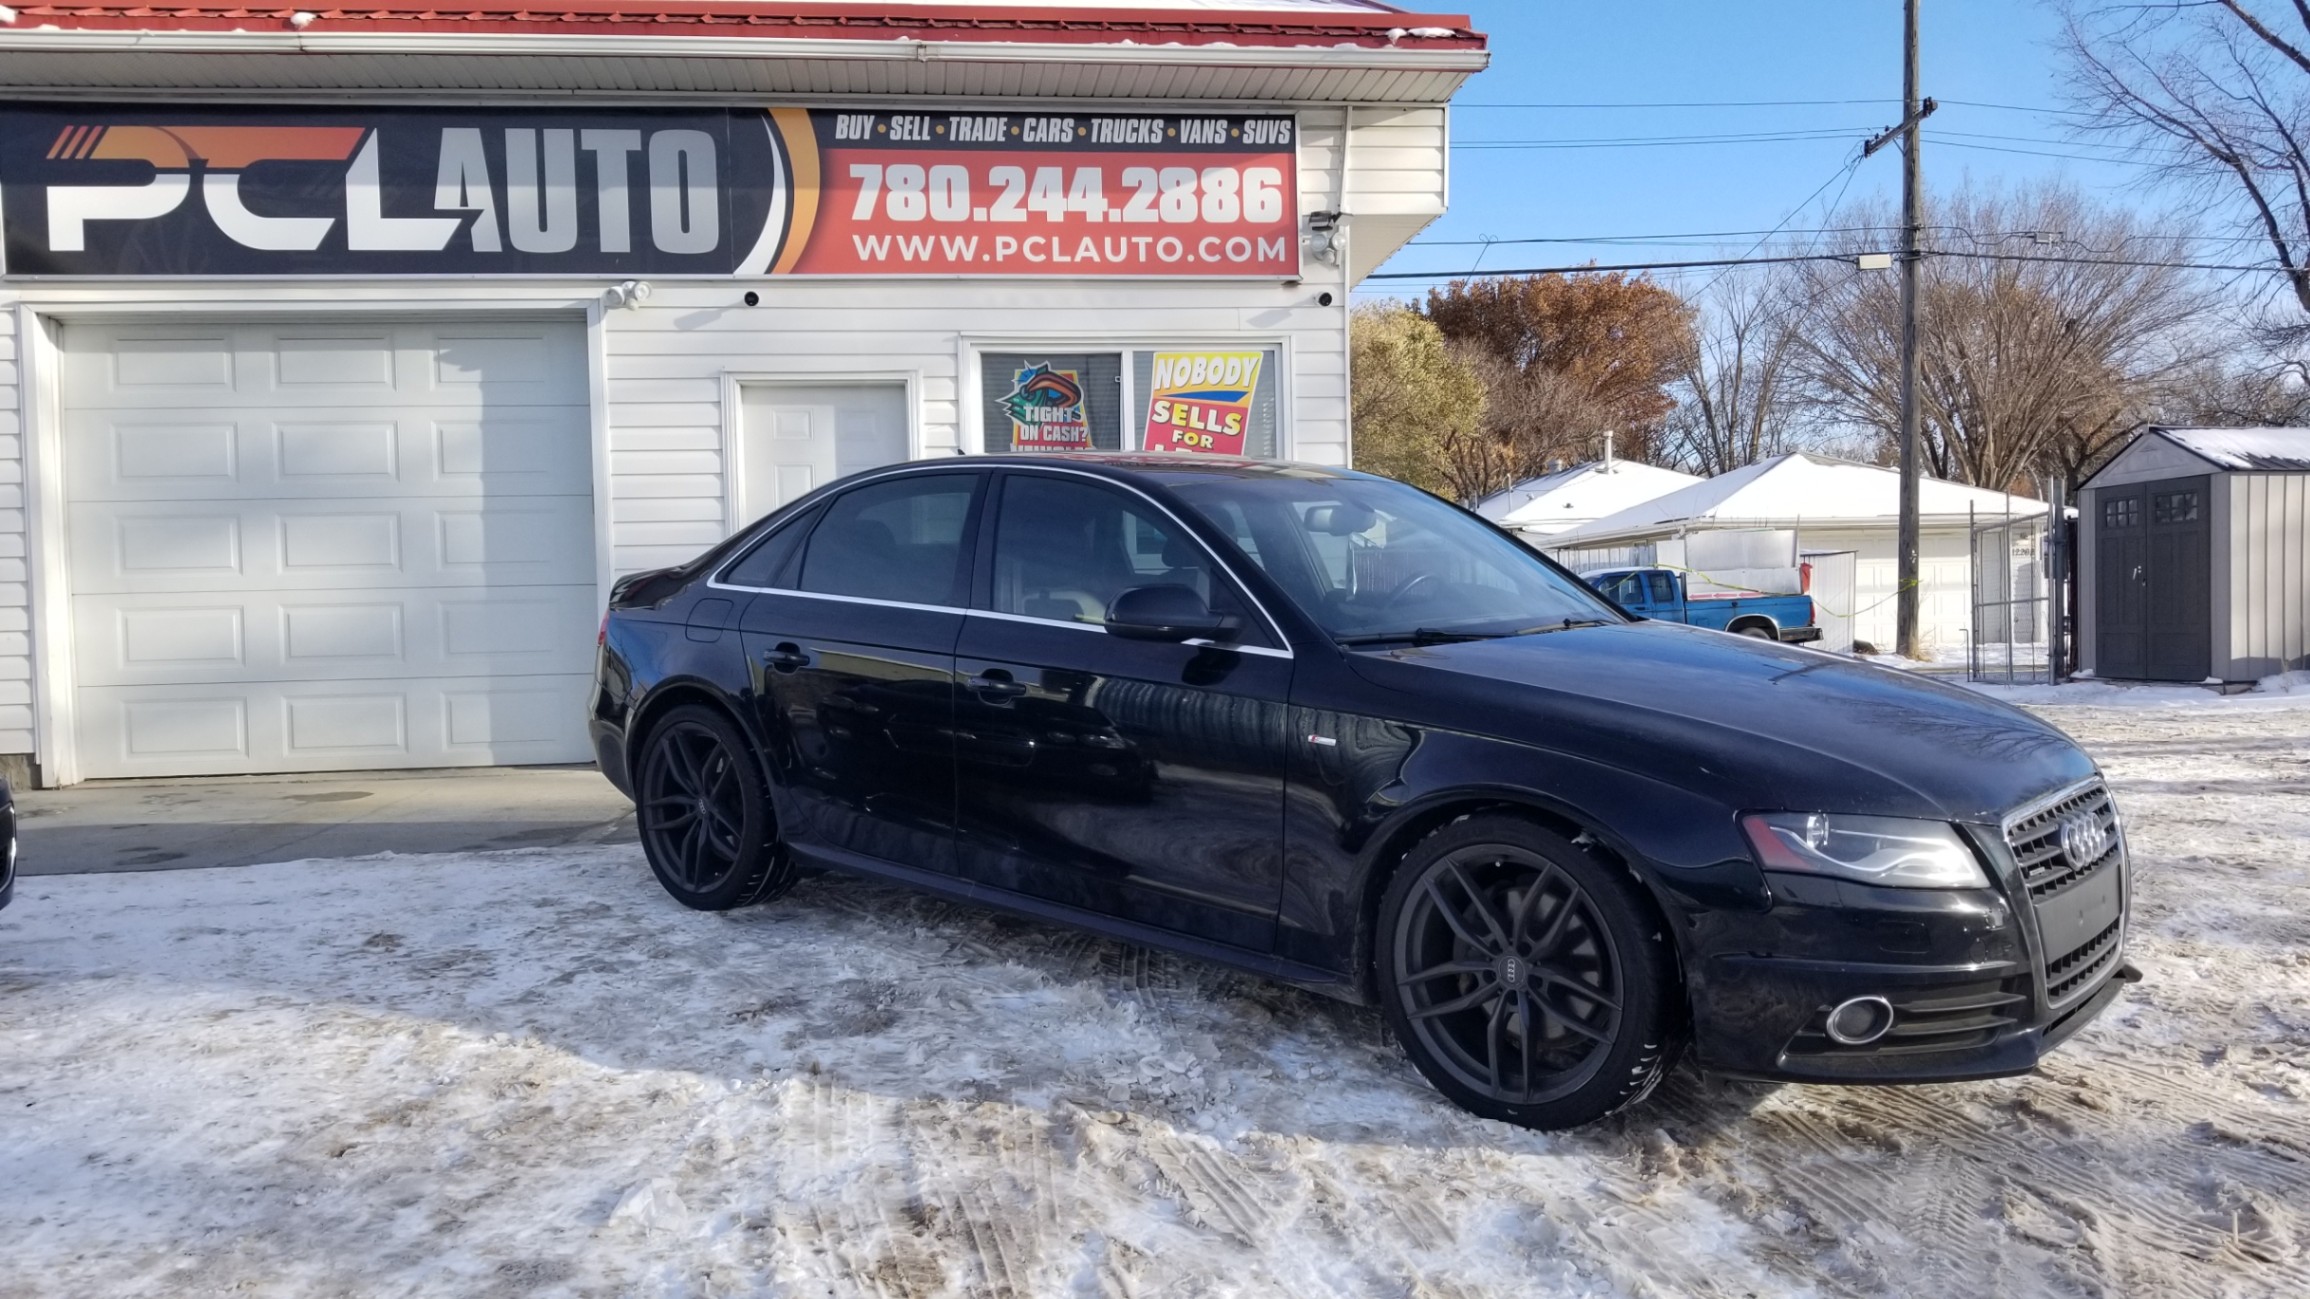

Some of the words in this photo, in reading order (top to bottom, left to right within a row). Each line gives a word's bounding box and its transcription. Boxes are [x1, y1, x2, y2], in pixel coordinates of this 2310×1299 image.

[835, 114, 875, 140] BUY
[889, 115, 931, 141] SELL
[949, 116, 1008, 142] TRADE
[1022, 117, 1075, 143] CARS
[1091, 118, 1164, 144] TRUCKS
[1180, 119, 1228, 144] VANS
[1242, 119, 1292, 145] SUVS
[849, 163, 1283, 224] 780.244.2886
[852, 234, 1286, 264] WWW.PCLAUTO.COM
[1154, 356, 1260, 390] NOBODY
[1023, 402, 1073, 423] TIGHT
[1151, 400, 1242, 436] SELLS
[1020, 424, 1039, 441] ON
[1043, 425, 1089, 442] CASH?
[1172, 429, 1214, 449] FOR
